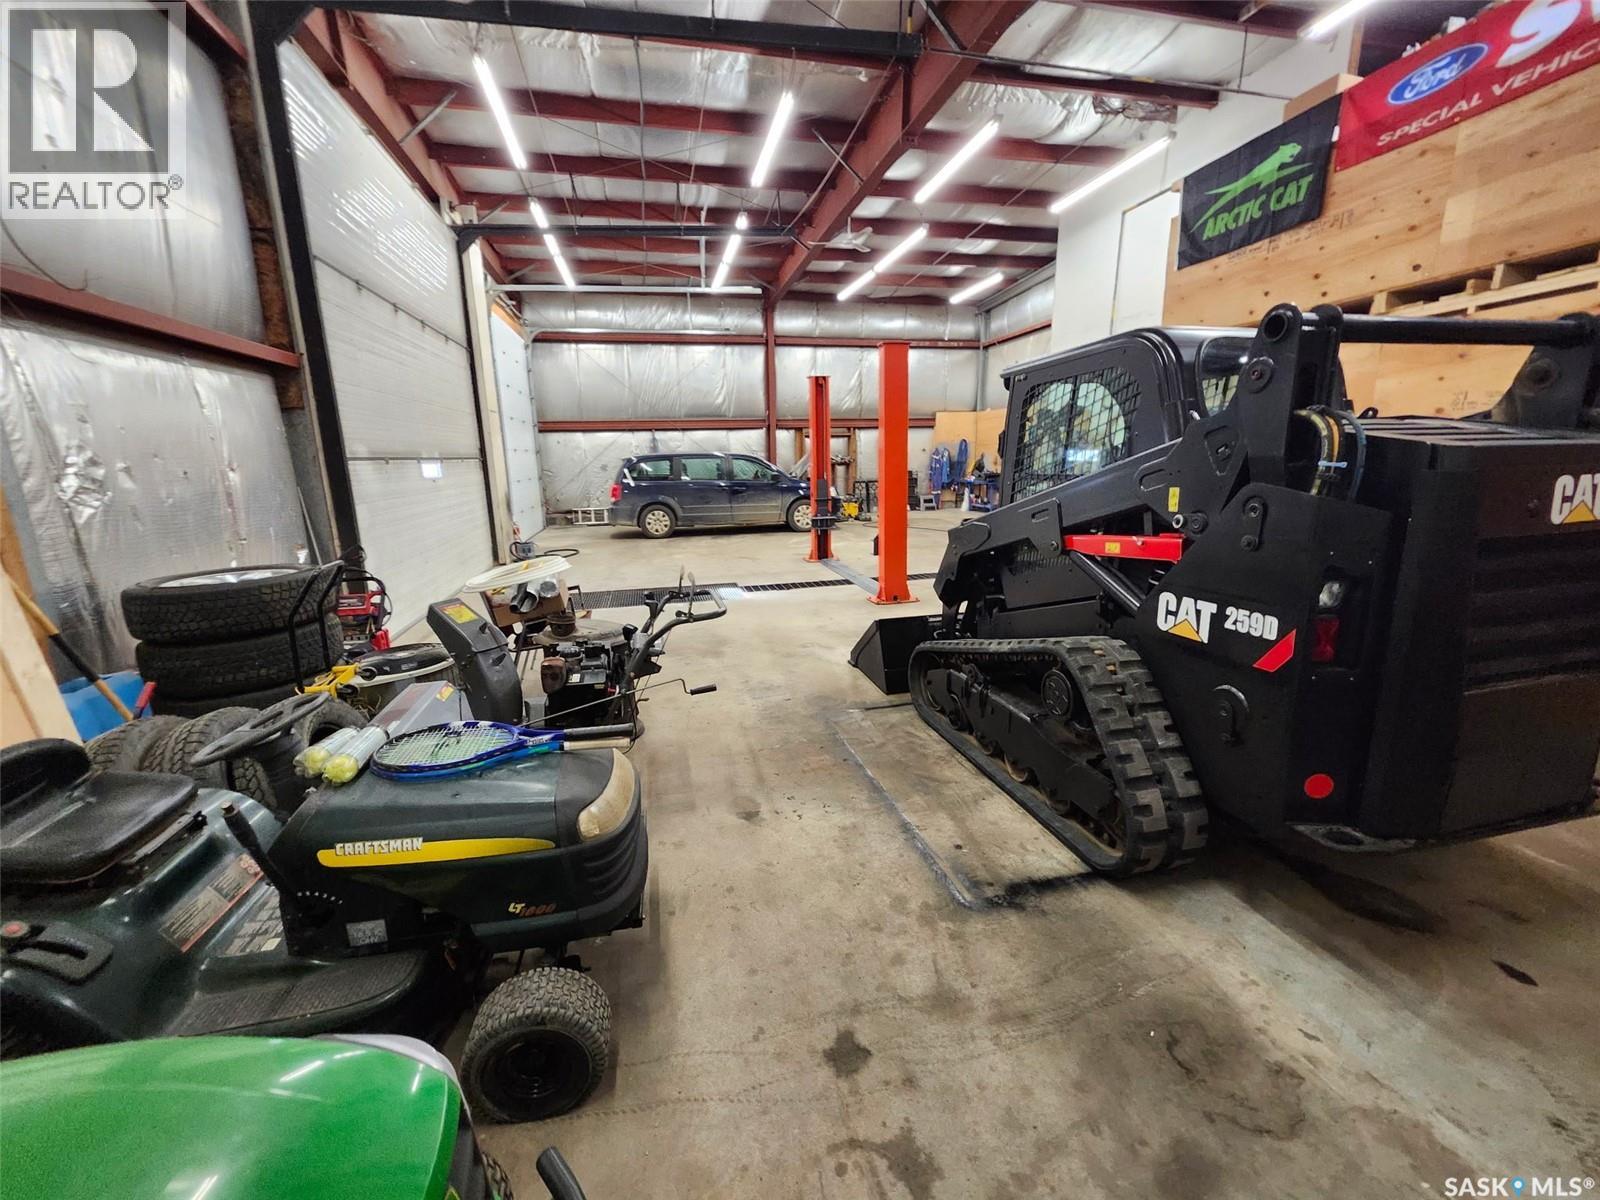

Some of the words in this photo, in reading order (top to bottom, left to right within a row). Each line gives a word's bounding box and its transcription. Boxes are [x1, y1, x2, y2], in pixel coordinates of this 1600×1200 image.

[1377, 91, 1483, 147] SPECIAL
[1491, 37, 1600, 97] VEHIC
[1403, 53, 1467, 99] Ford
[1202, 193, 1267, 241] ARCTIC
[1270, 173, 1314, 212] CAT
[1156, 591, 1218, 645] CAT
[1223, 605, 1280, 641] 259D
[335, 836, 424, 856] CRAFTSMAN
